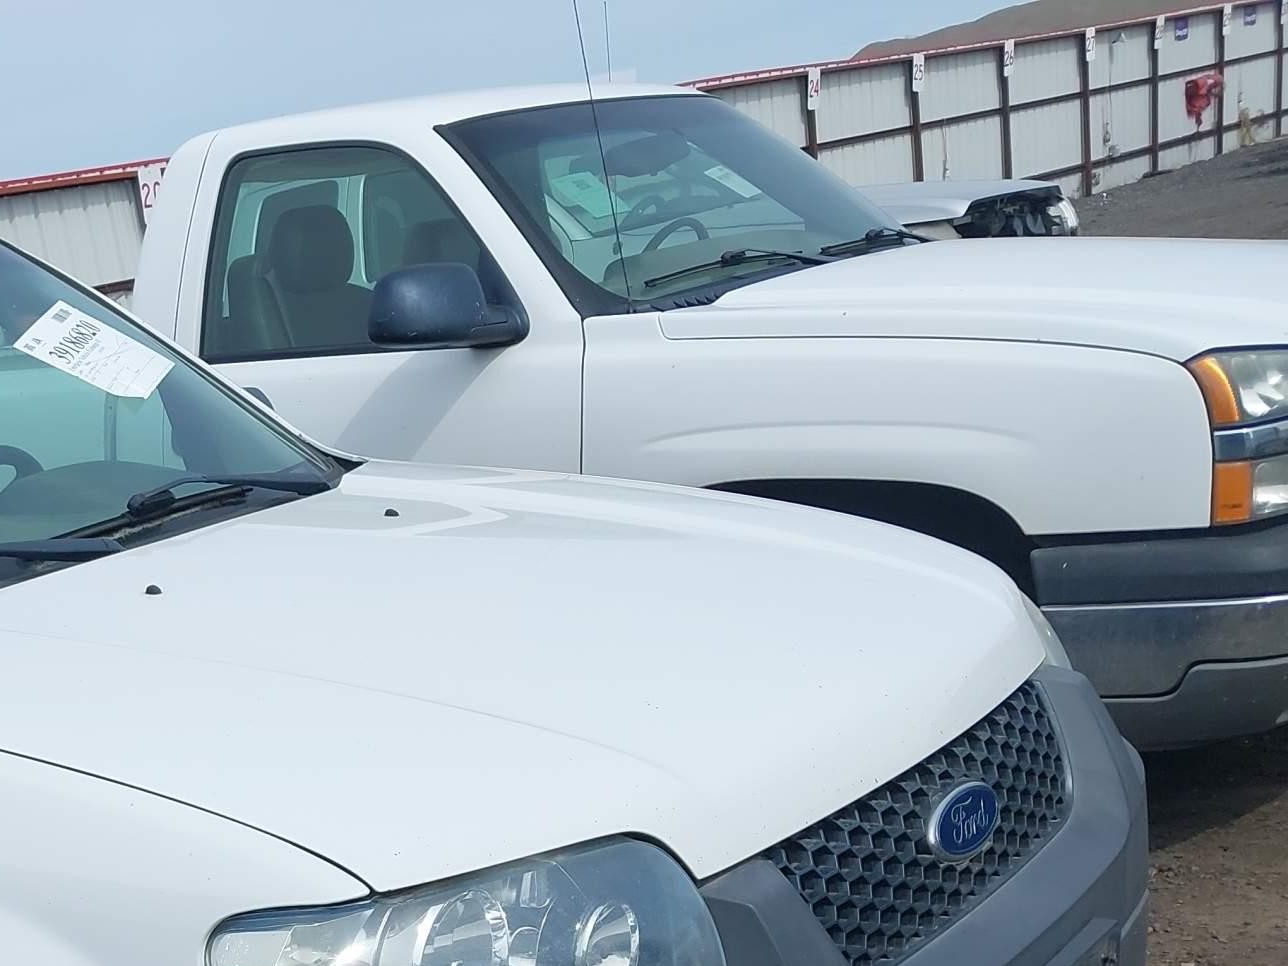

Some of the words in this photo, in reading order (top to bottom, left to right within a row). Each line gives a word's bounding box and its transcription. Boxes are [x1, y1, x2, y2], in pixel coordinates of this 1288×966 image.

[1004, 49, 1014, 67] 26
[913, 63, 924, 81] 25
[809, 78, 820, 98] 24
[49, 319, 102, 364] 39186820
[950, 796, 989, 844] Ford
